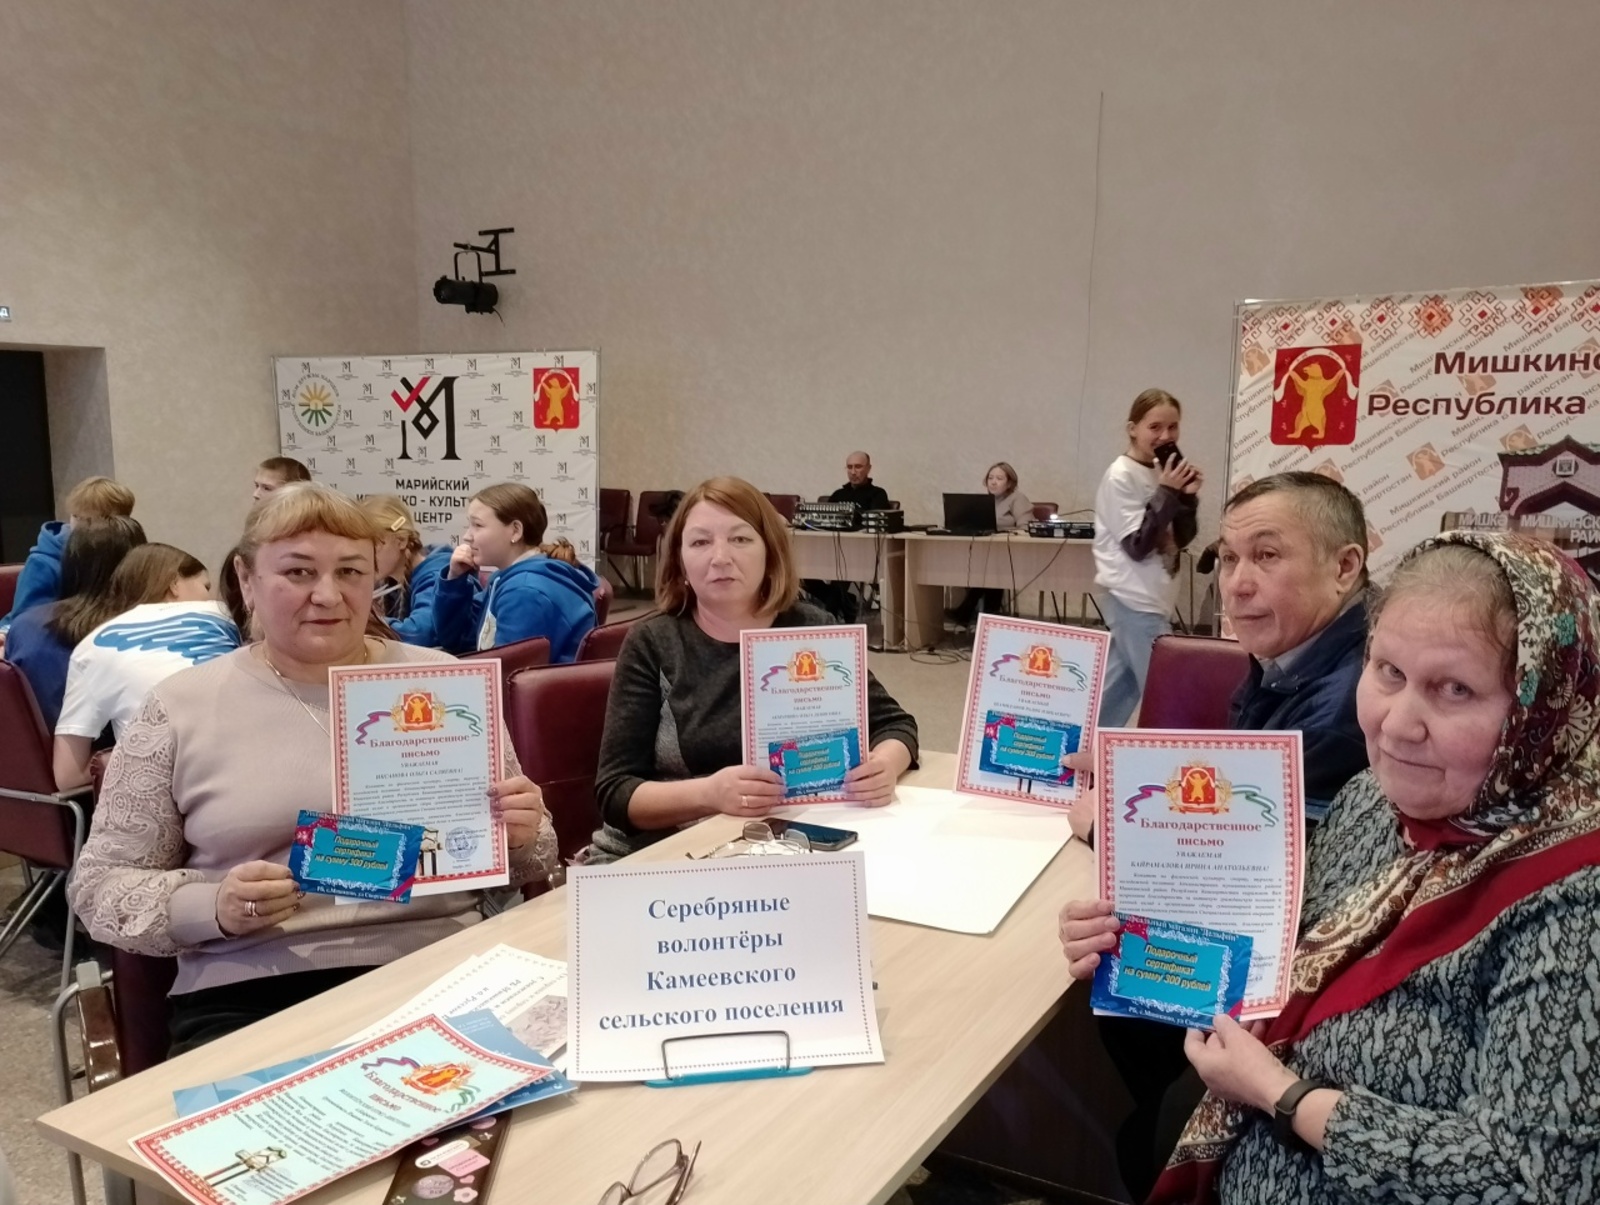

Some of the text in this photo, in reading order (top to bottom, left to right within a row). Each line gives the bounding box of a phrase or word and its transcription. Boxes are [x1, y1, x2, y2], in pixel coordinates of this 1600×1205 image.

[1367, 392, 1586, 420] Республика
[396, 477, 469, 491] МАРИЙСКИЙ
[1389, 457, 1482, 516] Мишкинский район
[1436, 460, 1500, 501] Башкортоста
[430, 496, 466, 508] КУЛЬТ
[414, 512, 452, 524] ЦЕНТР
[771, 685, 843, 696] Благодарственное
[999, 675, 1076, 693] Благодарственное
[1020, 690, 1051, 699] письмо
[370, 734, 470, 748] Благодарственное
[401, 750, 440, 758] письмо
[1141, 818, 1262, 832] Благодарственное
[335, 835, 379, 849] Подарочный
[1177, 838, 1224, 846] письмо
[334, 846, 376, 858] сертификат
[315, 854, 388, 870] на сумму 300 рублей
[648, 896, 790, 923] Серебряные
[657, 931, 783, 955] волонтёры
[1145, 944, 1198, 963] Подарочный
[1145, 958, 1195, 976] сертификат
[647, 967, 796, 991] Камеевского
[1124, 967, 1212, 992] на сумму 300 рублей
[599, 999, 844, 1031] сельского поселения
